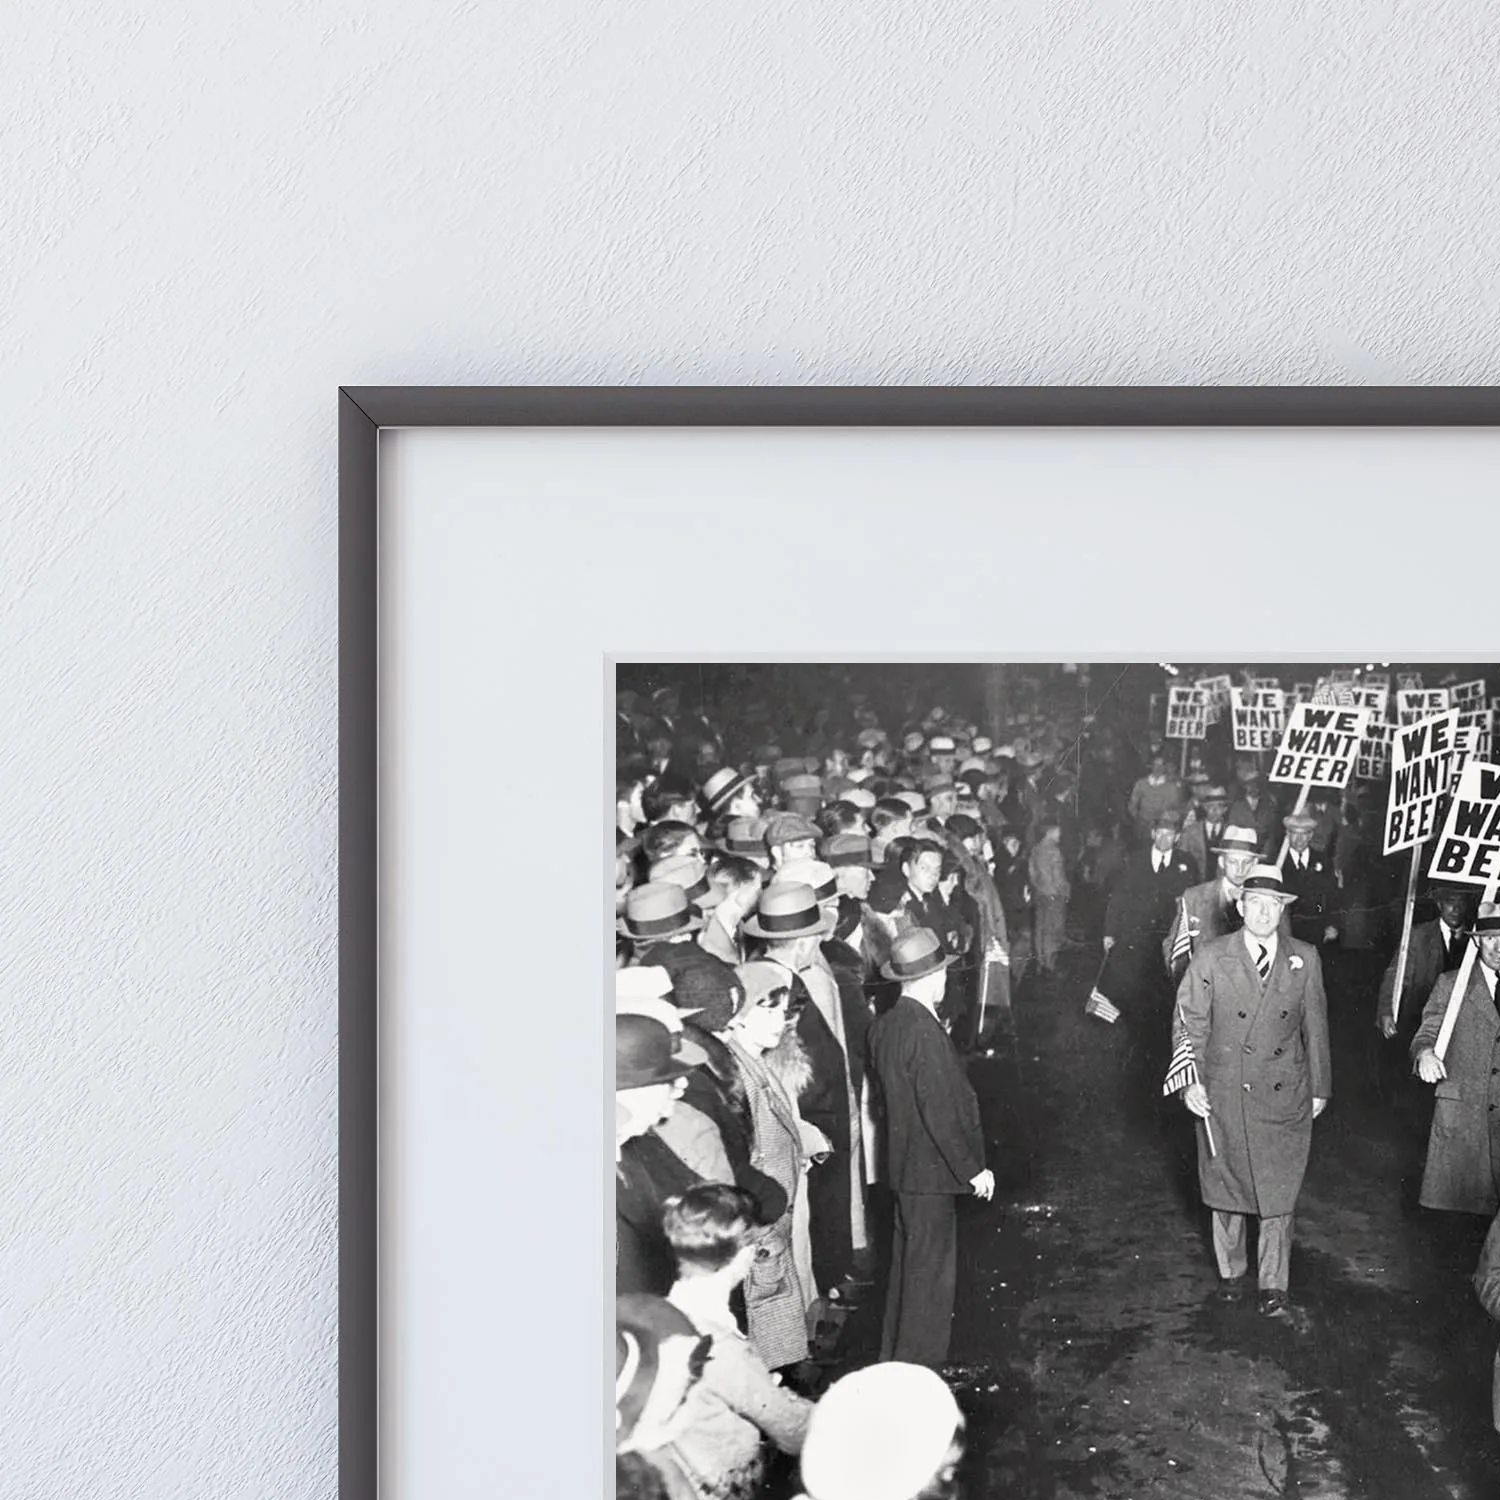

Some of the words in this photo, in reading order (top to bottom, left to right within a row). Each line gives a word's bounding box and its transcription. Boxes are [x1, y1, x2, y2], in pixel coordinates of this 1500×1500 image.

[1404, 694, 1442, 709] WE
[1168, 721, 1203, 735] BEER
[1235, 709, 1281, 728] WANT
[1304, 708, 1360, 732] WE
[1287, 729, 1359, 757] WANT
[1402, 718, 1449, 763] WE
[1275, 754, 1348, 783] BEER
[1395, 751, 1451, 807] WANT
[1388, 793, 1447, 849] BEER
